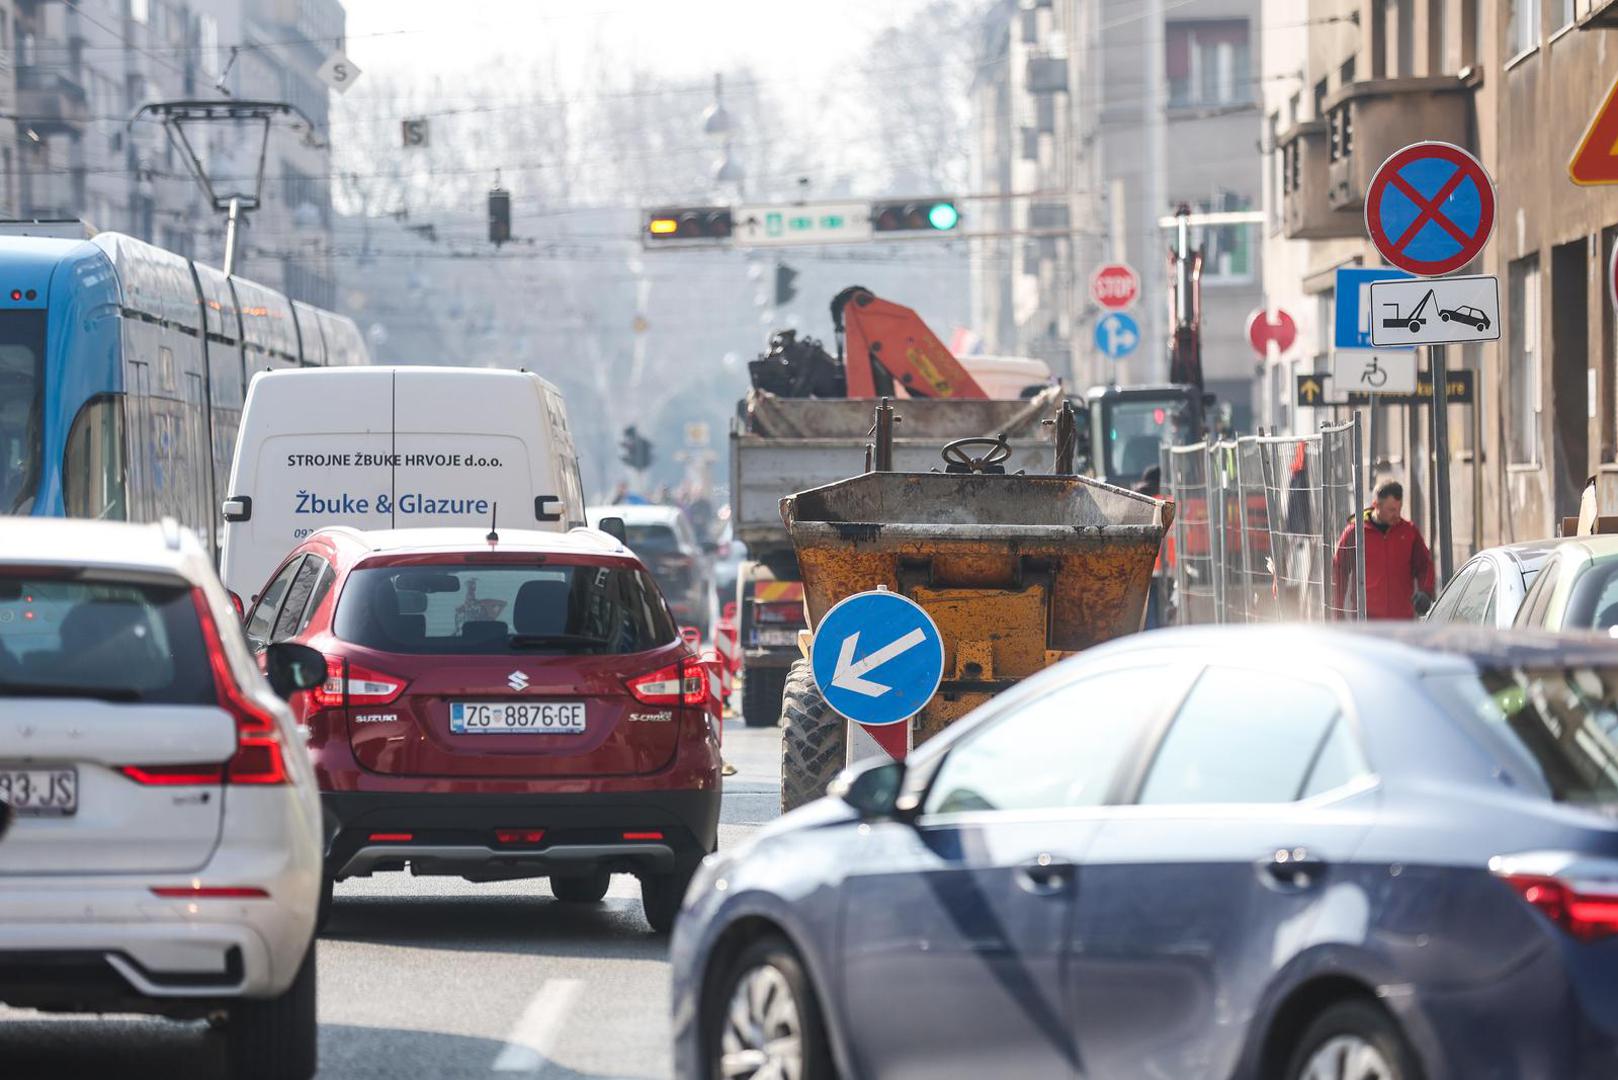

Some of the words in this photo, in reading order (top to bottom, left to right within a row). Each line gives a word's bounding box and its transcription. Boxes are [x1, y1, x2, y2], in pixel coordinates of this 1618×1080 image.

[333, 64, 347, 82] S
[408, 121, 424, 146] S
[1096, 277, 1136, 299] STOP
[287, 454, 351, 467] STROJNE
[354, 451, 401, 466] ŽBUKE
[405, 454, 461, 466] HRVOJE
[464, 454, 503, 467] d.o.o.
[295, 490, 369, 514] Žbuke
[375, 494, 393, 514] &
[398, 493, 489, 514] Glazure
[355, 714, 398, 723] SUZUKI
[466, 706, 491, 727] ZG
